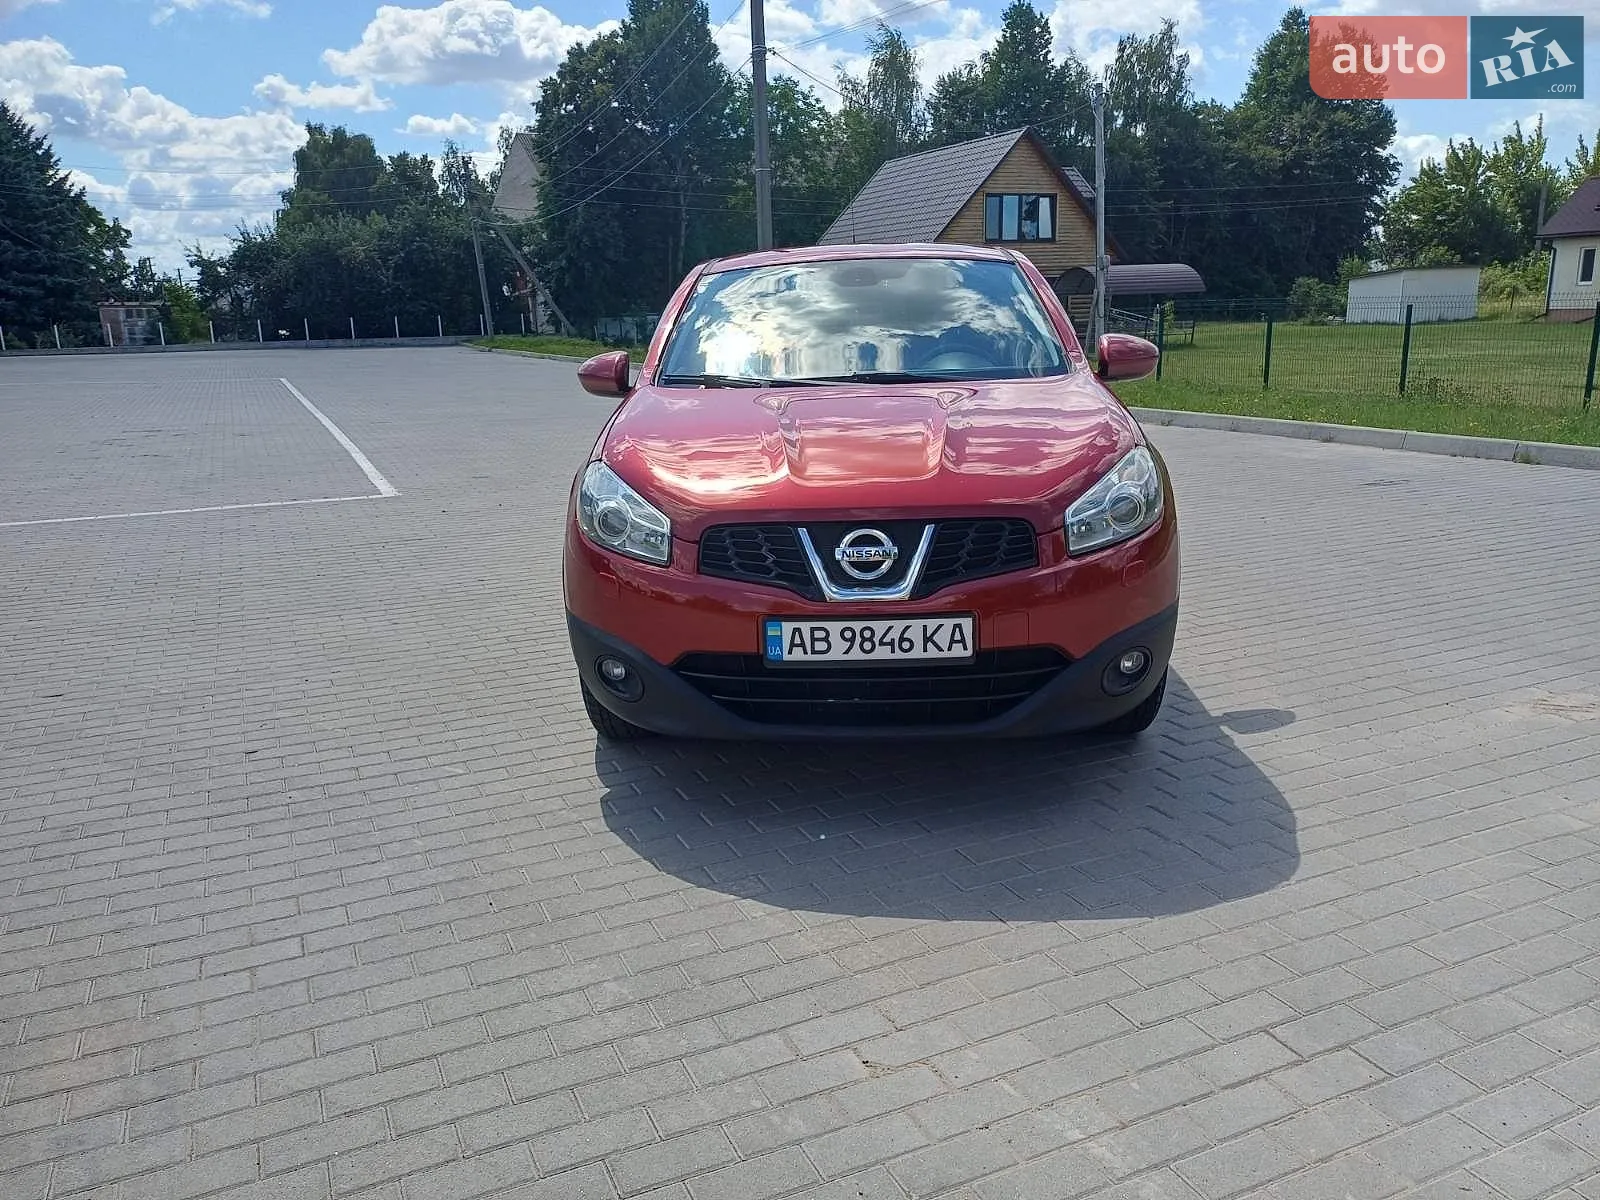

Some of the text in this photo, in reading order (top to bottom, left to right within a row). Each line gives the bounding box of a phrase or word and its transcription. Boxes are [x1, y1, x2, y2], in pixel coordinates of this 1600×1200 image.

[841, 549, 893, 559] NISSAN
[787, 623, 969, 656] AB 9846 KA
[768, 646, 782, 656] UA
